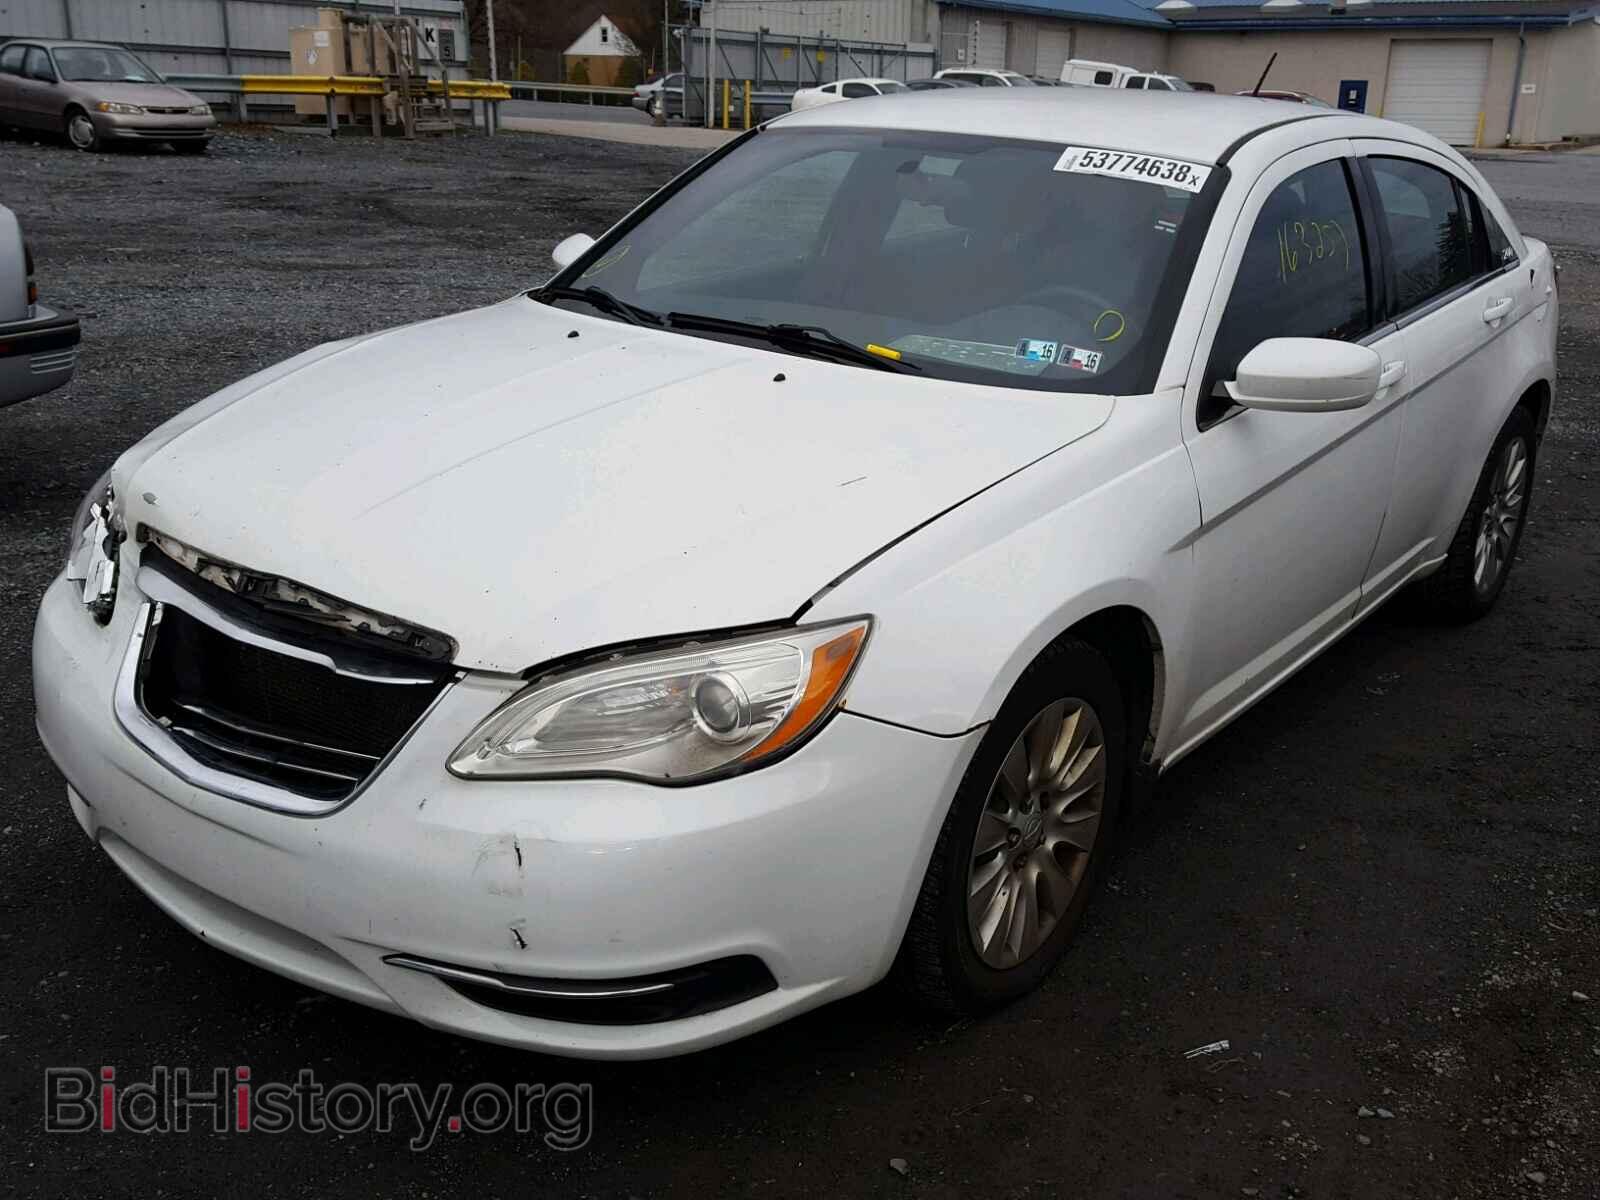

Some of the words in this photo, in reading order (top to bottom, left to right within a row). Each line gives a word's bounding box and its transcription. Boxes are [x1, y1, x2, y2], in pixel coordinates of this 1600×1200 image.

[425, 27, 435, 42] K
[1079, 150, 1192, 183] 53774638
[1041, 344, 1054, 358] 16
[1084, 352, 1098, 368] 16
